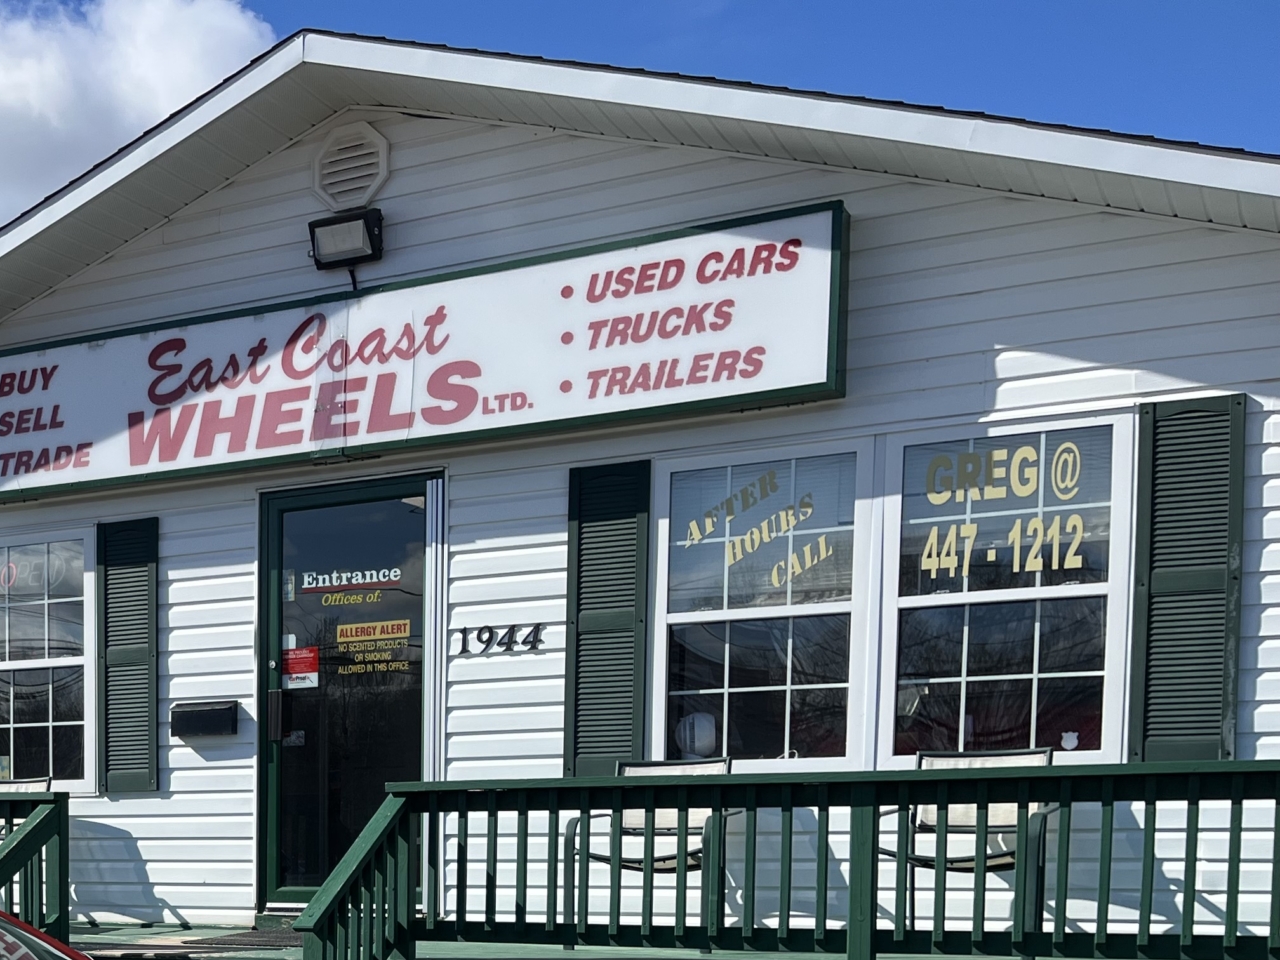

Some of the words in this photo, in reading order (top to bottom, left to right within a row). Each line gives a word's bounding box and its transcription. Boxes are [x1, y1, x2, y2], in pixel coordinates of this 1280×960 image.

[586, 259, 685, 303] USED
[696, 239, 802, 285] CARS
[588, 299, 735, 350] TRUCKS
[147, 337, 270, 405] East
[281, 305, 450, 380] Coast
[587, 346, 766, 399] TRAILERS
[128, 360, 482, 466] WHEELS
[482, 392, 533, 414] LTD.
[926, 446, 1038, 505] GREG
[1051, 442, 1081, 500] @
[685, 470, 779, 548] AFTER
[728, 492, 813, 566] HOURS
[1, 558, 60, 587] OPEN
[302, 567, 401, 588] Entrance
[771, 534, 833, 588] CALL
[322, 592, 363, 606] Offices
[366, 590, 382, 602] of:
[338, 644, 347, 652] NO
[349, 642, 375, 651] SCENTED
[377, 639, 408, 649] PRODUCTS
[339, 625, 377, 638] ALLERGY
[380, 623, 408, 635] ALERT
[458, 623, 543, 655] 1944
[338, 664, 365, 674] ALLOWED
[367, 664, 373, 672] IN
[374, 663, 387, 671] THIS
[388, 661, 409, 671] OFFICE
[355, 654, 363, 662] OR
[365, 652, 391, 661] SMOKING
